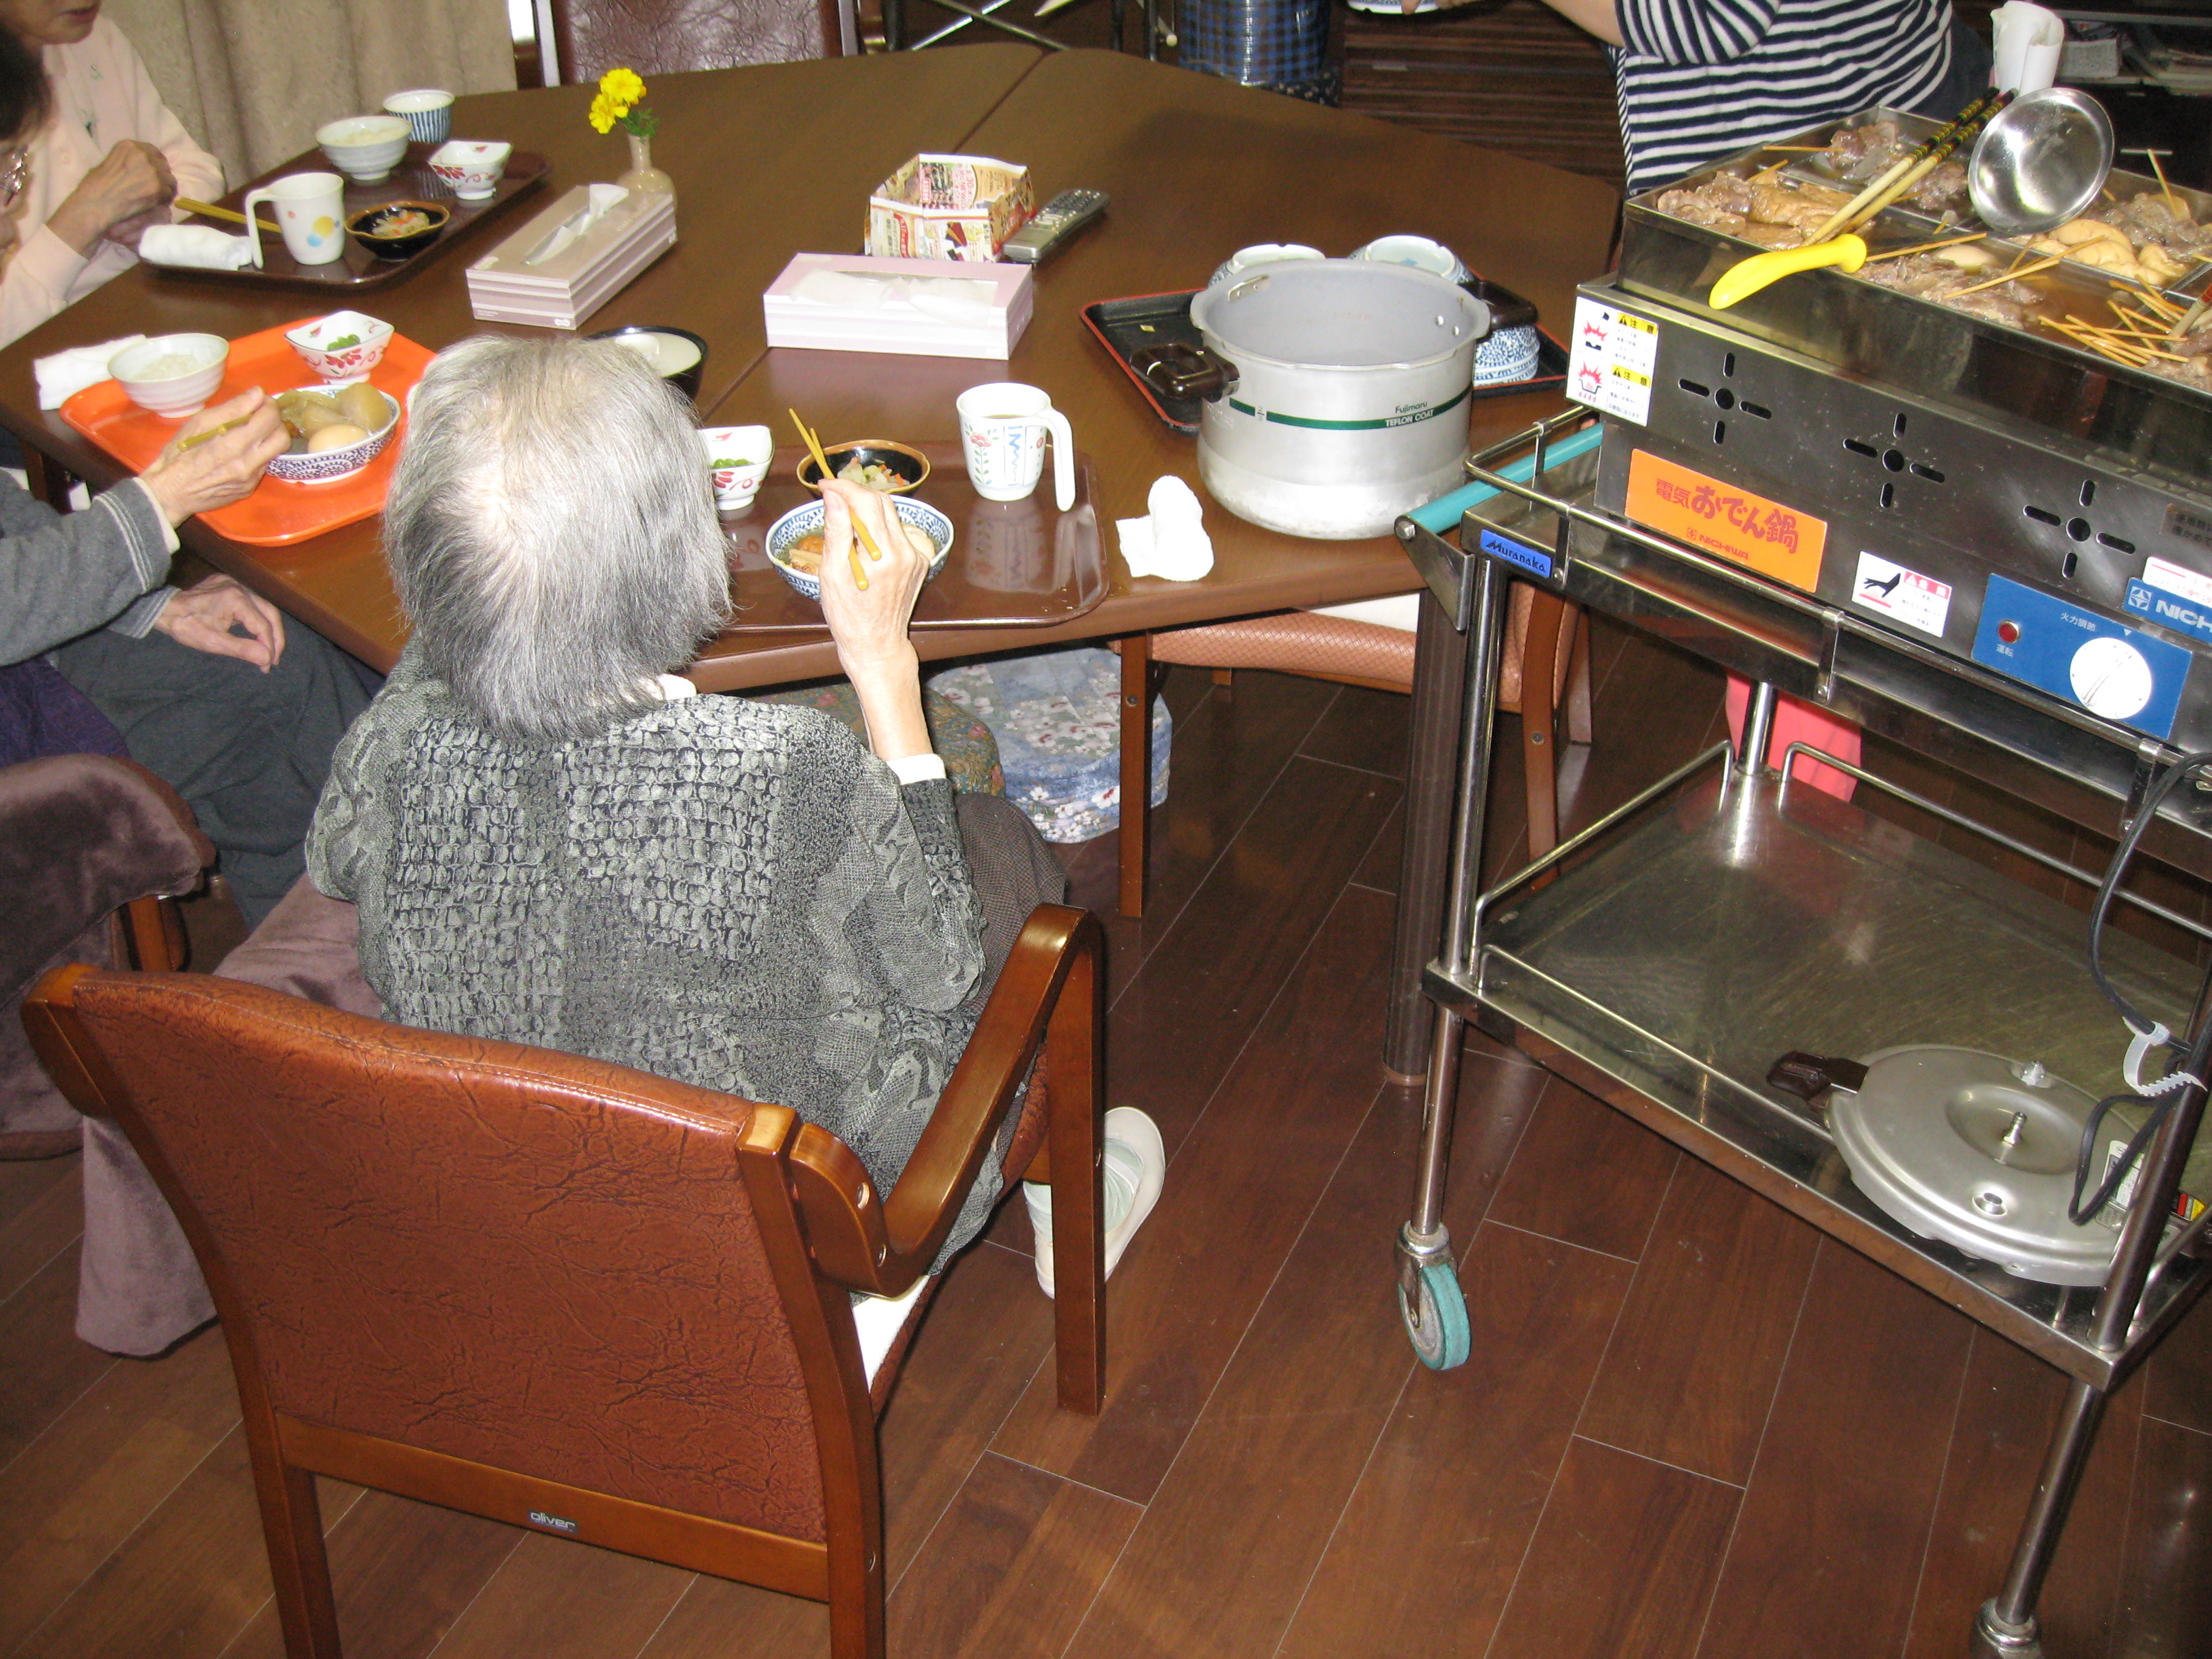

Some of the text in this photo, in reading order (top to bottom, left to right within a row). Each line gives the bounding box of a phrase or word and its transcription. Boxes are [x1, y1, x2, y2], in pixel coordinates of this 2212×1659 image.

[1395, 401, 1427, 414] Fujimaru
[1385, 409, 1434, 427] TEFLON COAT
[1486, 540, 1546, 572] Muranaka
[1699, 534, 1749, 560] NICHIWA
[2060, 612, 2097, 632] 火力調節
[1996, 643, 2014, 657] 運転
[530, 1512, 576, 1529] oliver
